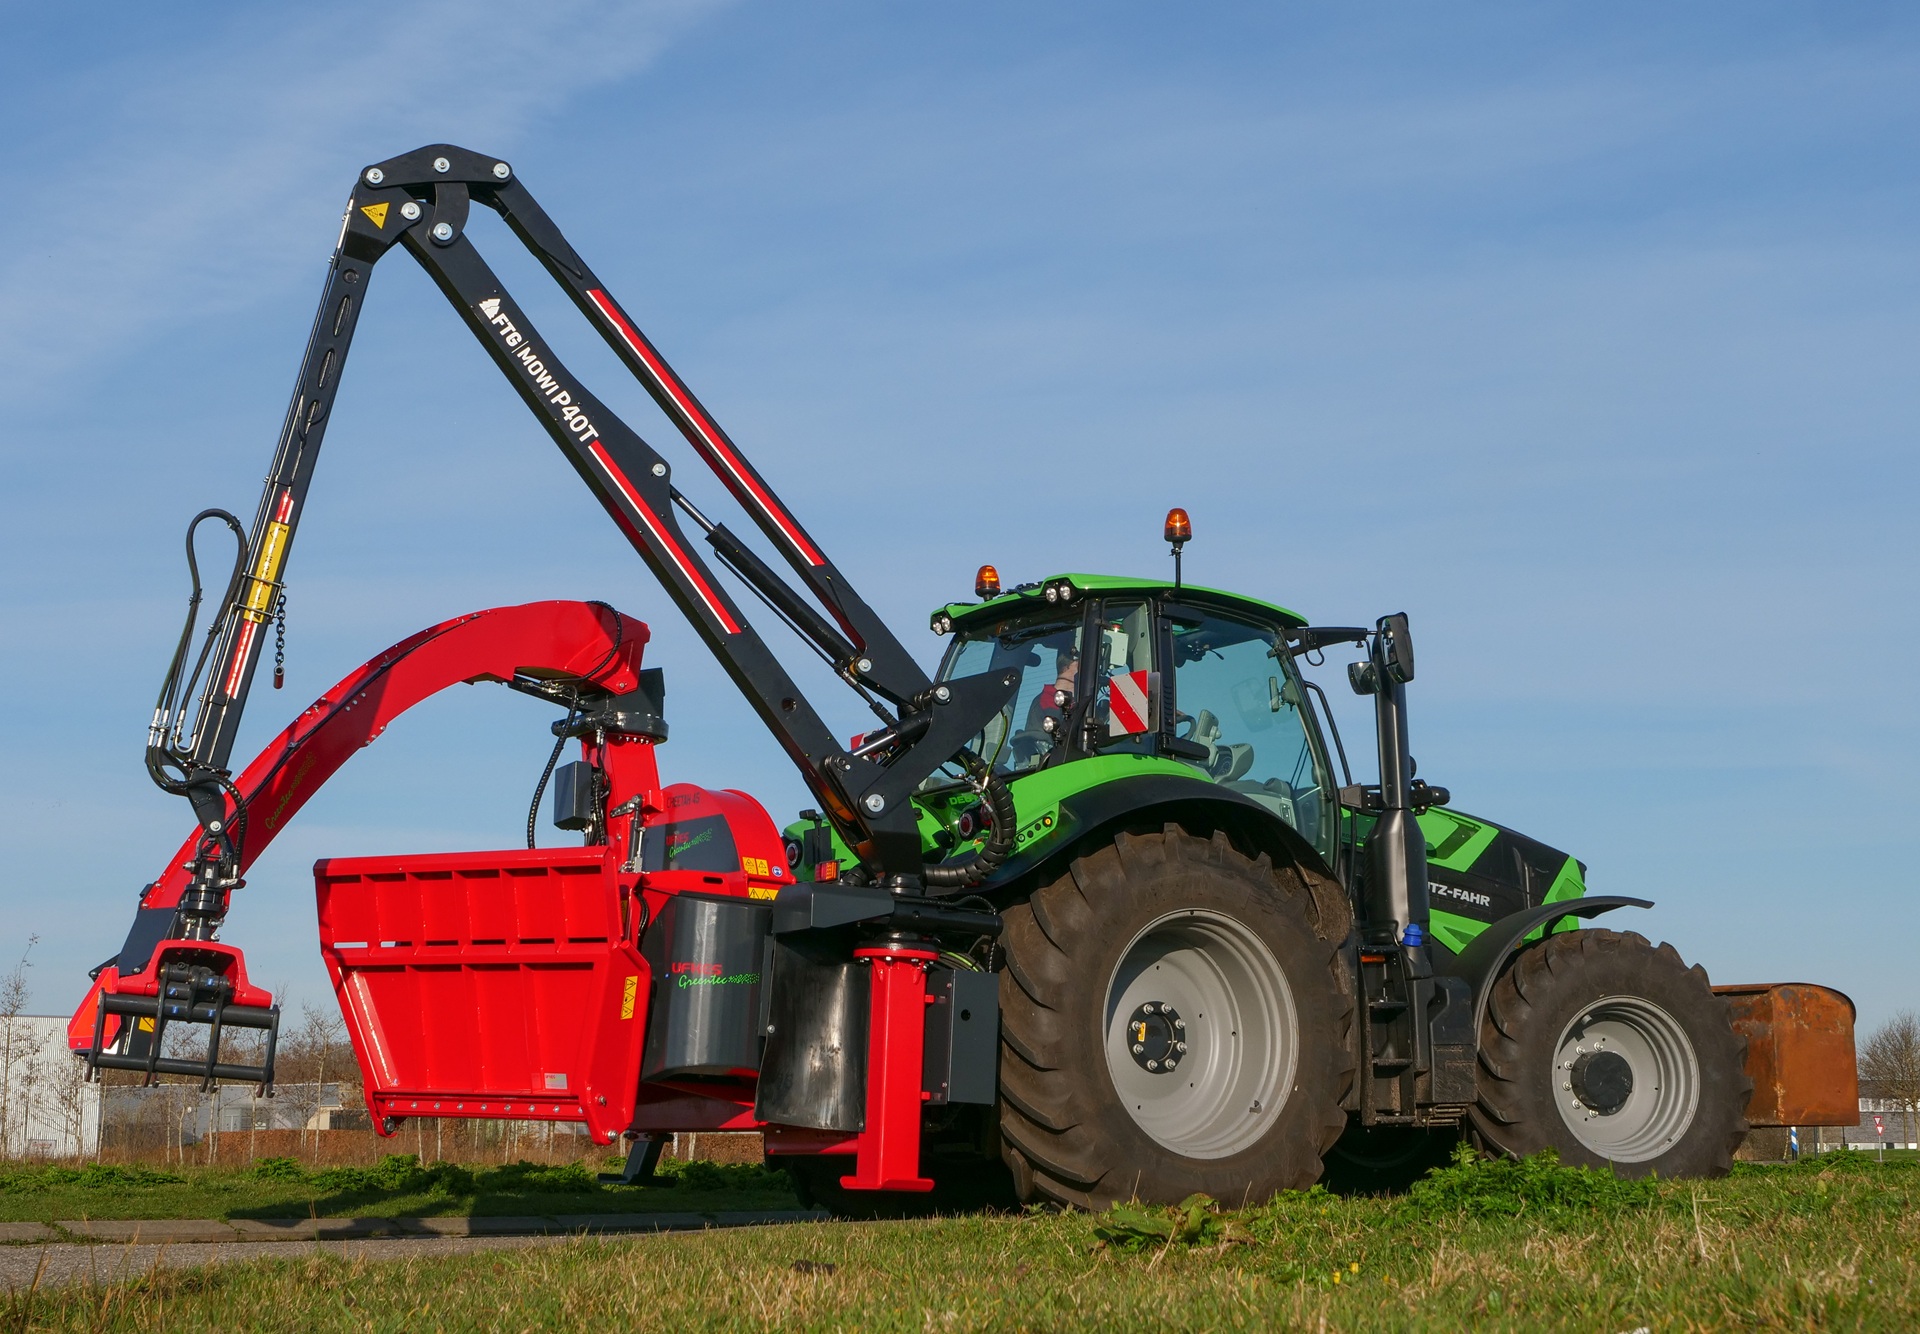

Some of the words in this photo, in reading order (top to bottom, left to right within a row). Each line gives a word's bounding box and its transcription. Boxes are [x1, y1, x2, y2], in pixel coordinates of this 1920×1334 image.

[491, 312, 522, 347] FTG
[517, 347, 559, 396] MOWI
[551, 390, 599, 442] P40T
[671, 962, 722, 976] UFKES
[678, 974, 728, 989] Greentec
